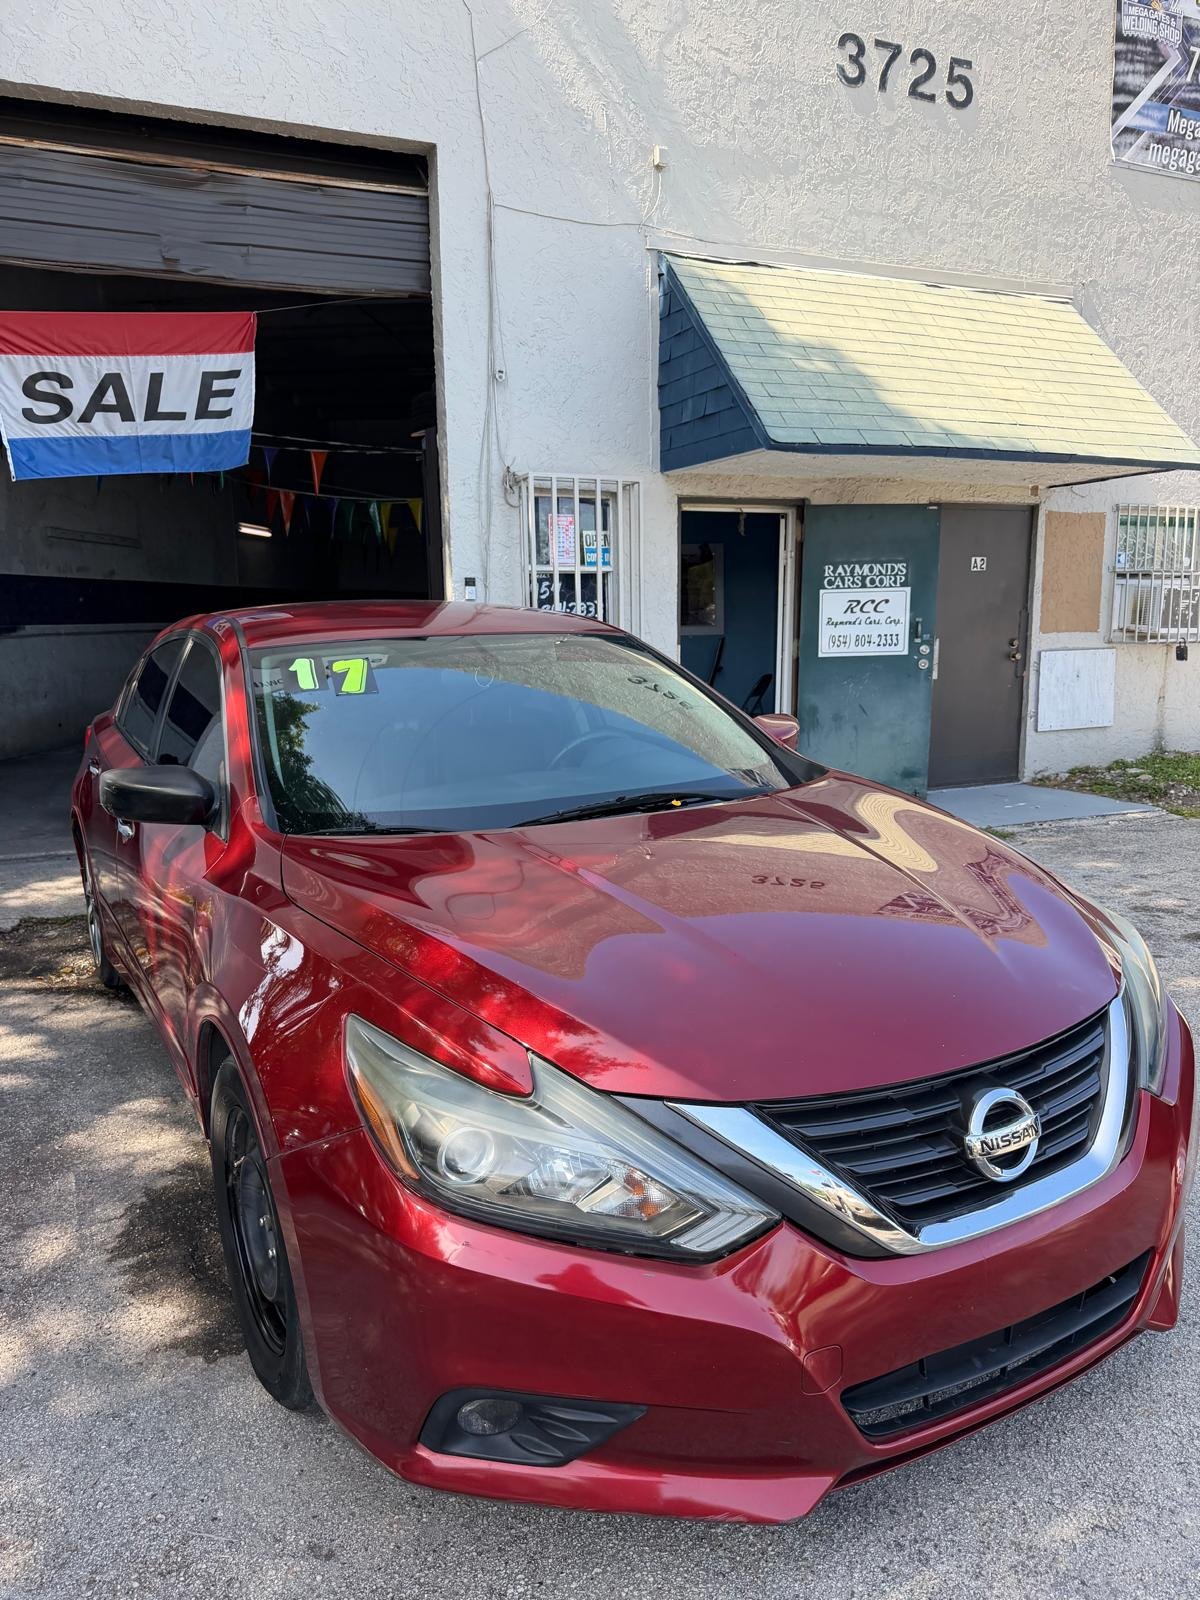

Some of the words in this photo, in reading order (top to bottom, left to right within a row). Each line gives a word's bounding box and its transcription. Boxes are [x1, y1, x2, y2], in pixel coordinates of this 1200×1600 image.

[1128, 6, 1149, 17] MEGA
[1149, 10, 1170, 25] GATES
[1170, 18, 1176, 27] &
[1123, 15, 1157, 35] WELDING
[1160, 23, 1180, 43] SHOP
[836, 32, 974, 109] 3725
[22, 369, 242, 425] SALE
[584, 533, 610, 547] OPN
[824, 563, 907, 577] RAYMOND'S
[972, 558, 985, 570] A2
[824, 576, 862, 589] CARS
[865, 575, 906, 588] CORP
[843, 599, 890, 614] RCC
[826, 617, 862, 628] Raymond's
[828, 634, 852, 650] (954)
[855, 633, 899, 648] 804-2333
[980, 1123, 1039, 1153] NISSAN
